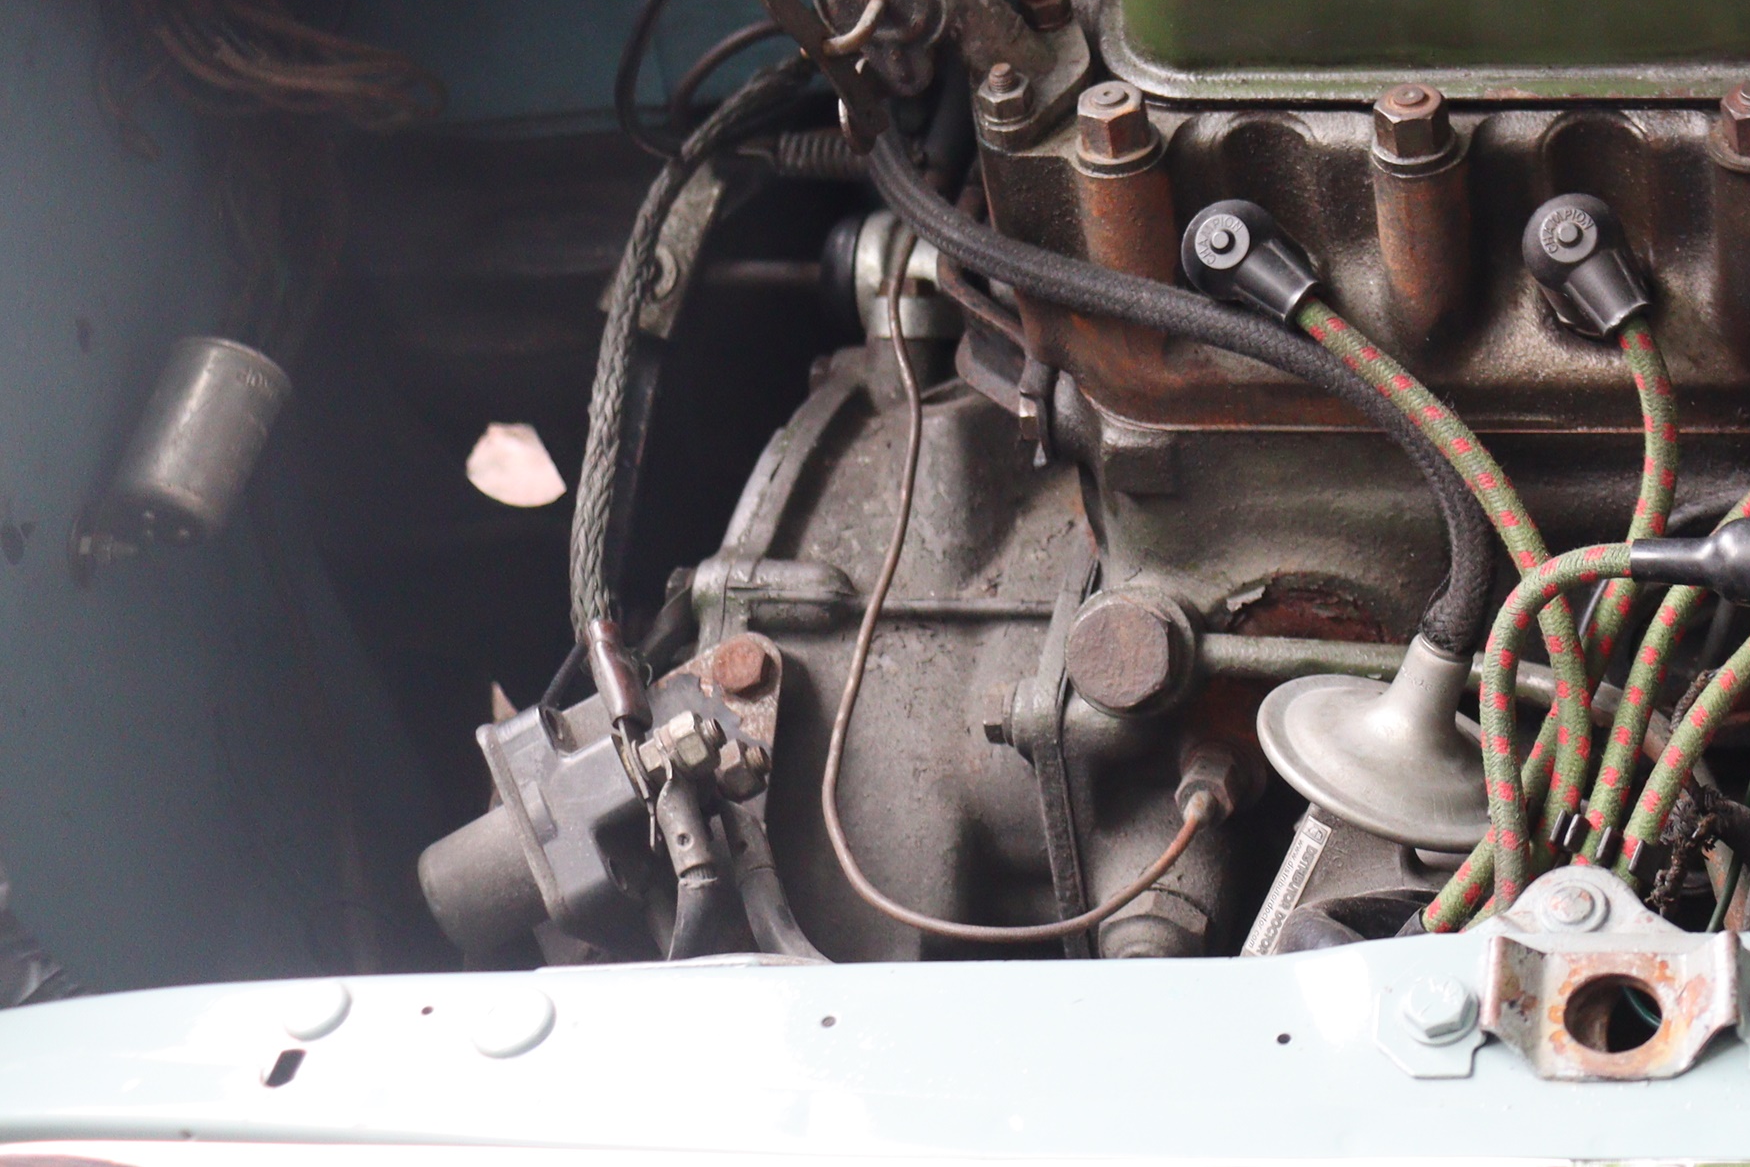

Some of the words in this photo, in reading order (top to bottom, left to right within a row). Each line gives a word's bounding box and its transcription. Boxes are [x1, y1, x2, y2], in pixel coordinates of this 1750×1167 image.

[1197, 216, 1243, 265] CHAMPION
[1543, 209, 1594, 254] CHAMPION
[1278, 844, 1318, 911] DISTRIBUTOR
[1256, 912, 1286, 955] DOCTOR
